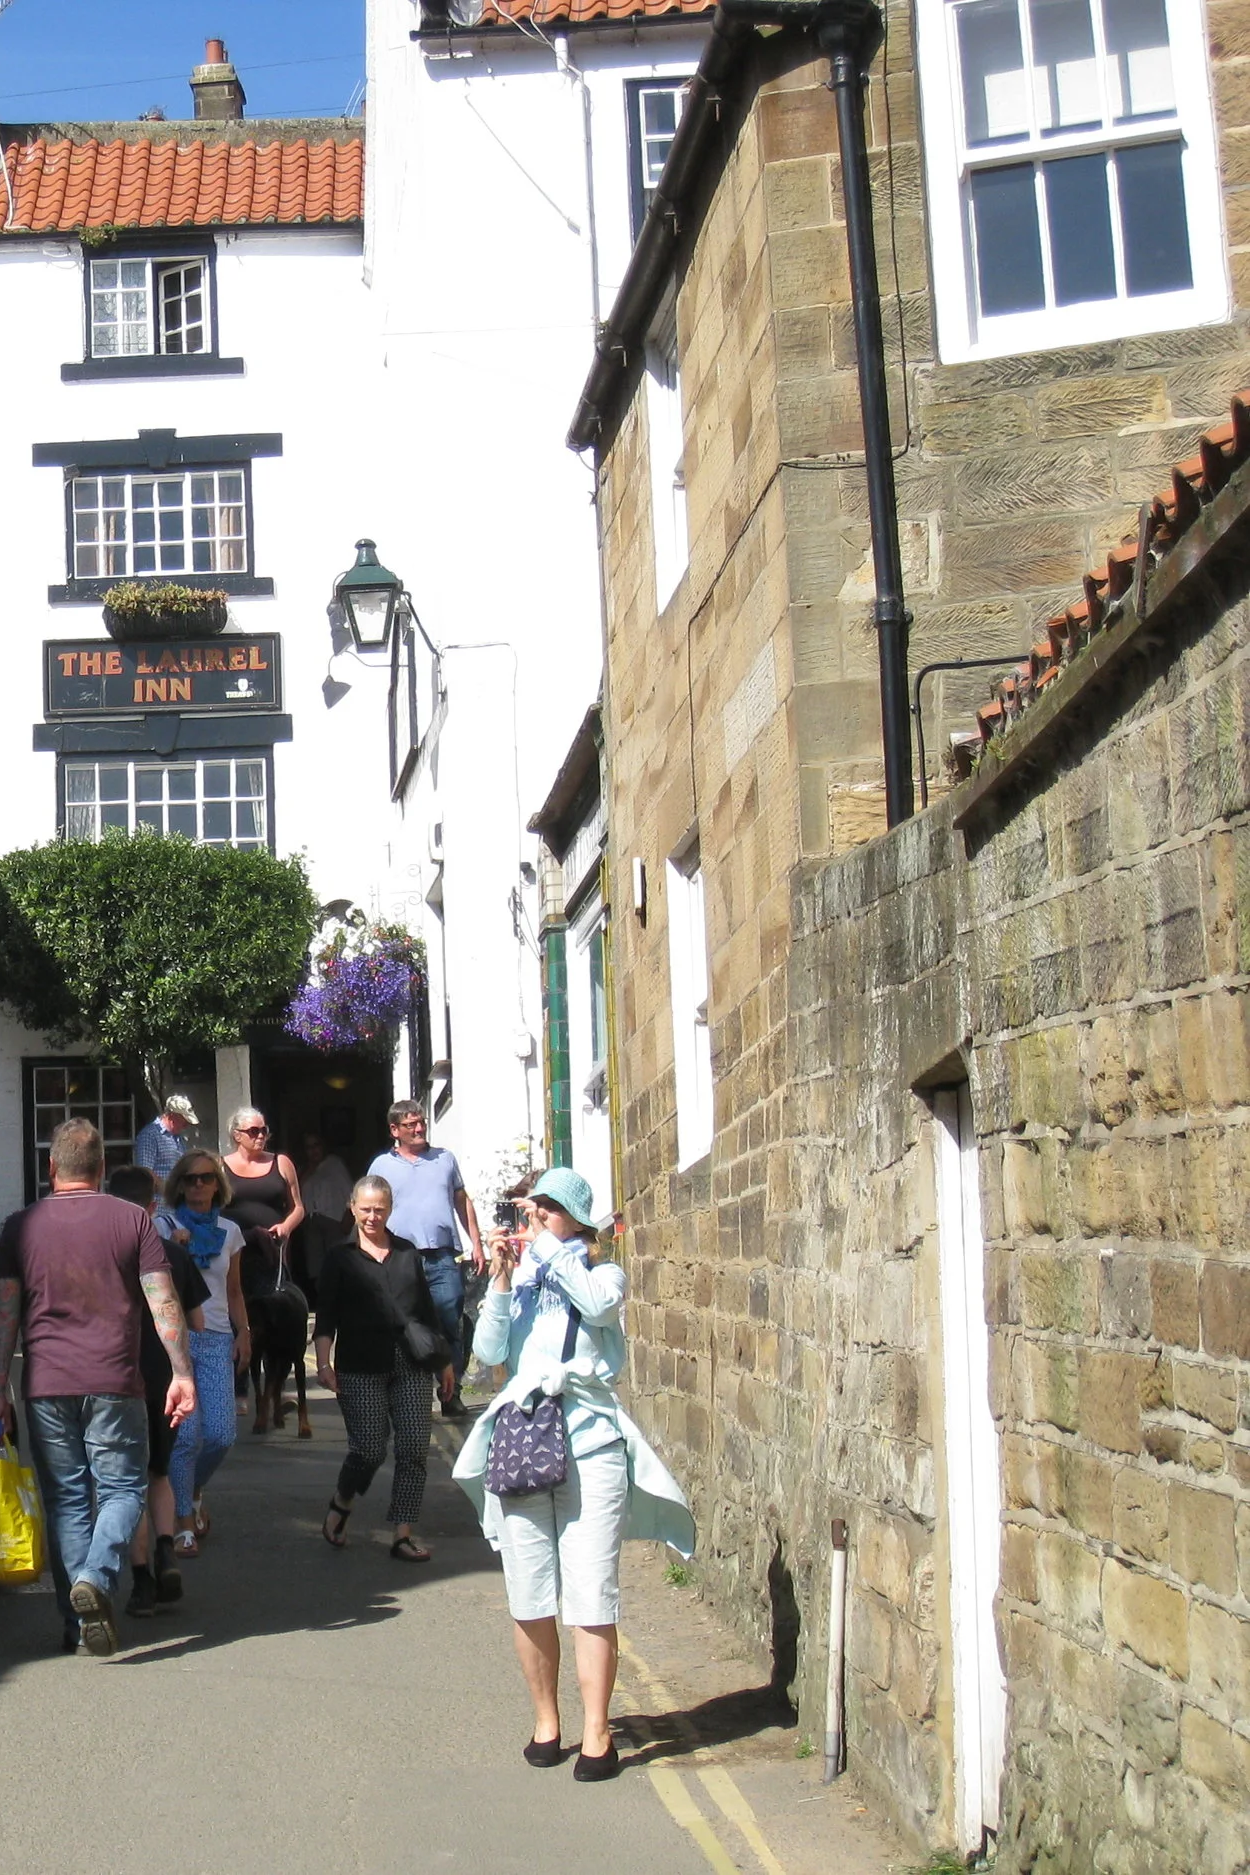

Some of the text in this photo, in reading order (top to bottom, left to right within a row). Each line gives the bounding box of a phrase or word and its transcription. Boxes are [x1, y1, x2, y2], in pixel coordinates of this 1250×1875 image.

[58, 645, 269, 676] THE LAUREL
[133, 677, 193, 703] INN
